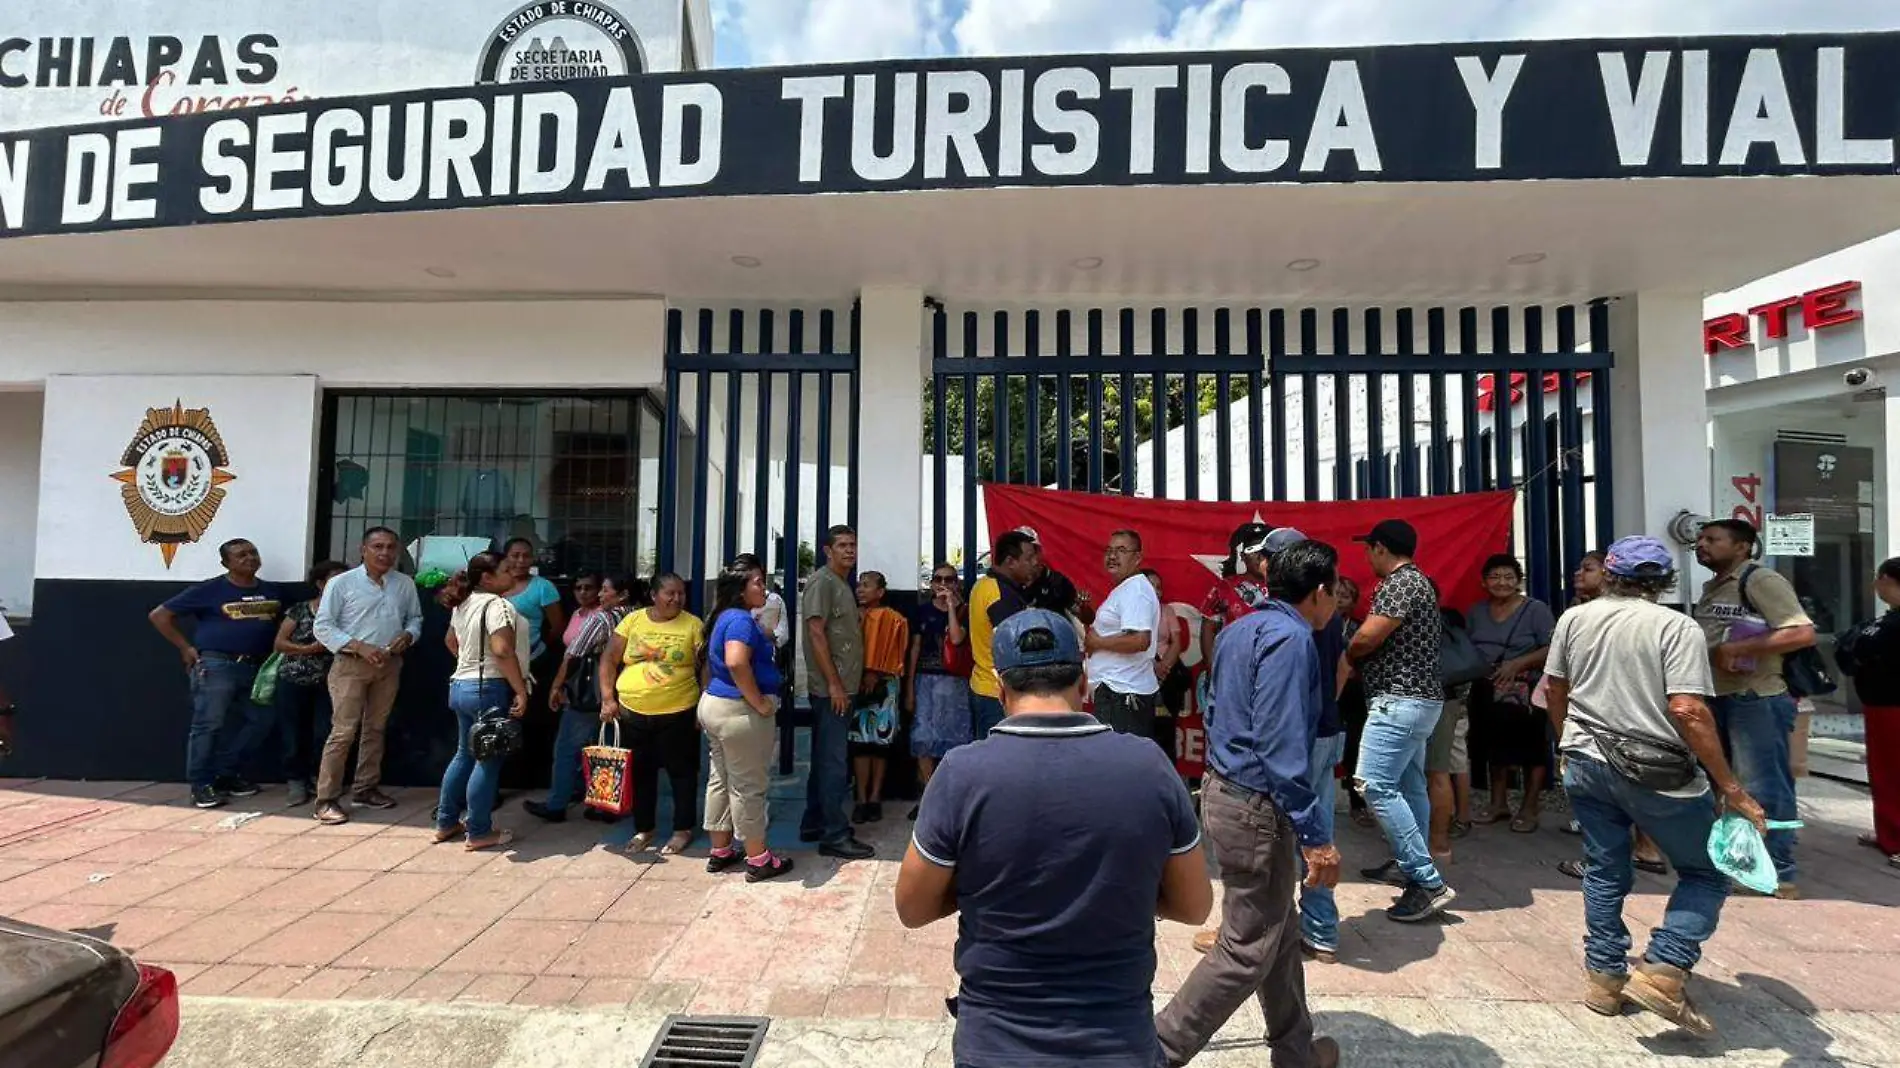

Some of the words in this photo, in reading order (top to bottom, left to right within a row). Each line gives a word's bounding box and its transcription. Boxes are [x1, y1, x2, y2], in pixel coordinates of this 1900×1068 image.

[499, 5, 544, 42] ESTADO
[551, 2, 566, 14] DE
[573, 2, 628, 40] CHIAPAS
[0, 33, 279, 88] CHIAPAS
[510, 66, 528, 80] DE
[515, 49, 603, 65] SECRETARIA
[100, 88, 127, 116] de
[61, 126, 162, 224] DE
[199, 83, 723, 214] SEGURIDAD
[781, 60, 1383, 182] TURISTICA
[1454, 54, 1527, 169] Y
[1597, 46, 1894, 166] VIAL
[1704, 280, 1864, 355] RTE
